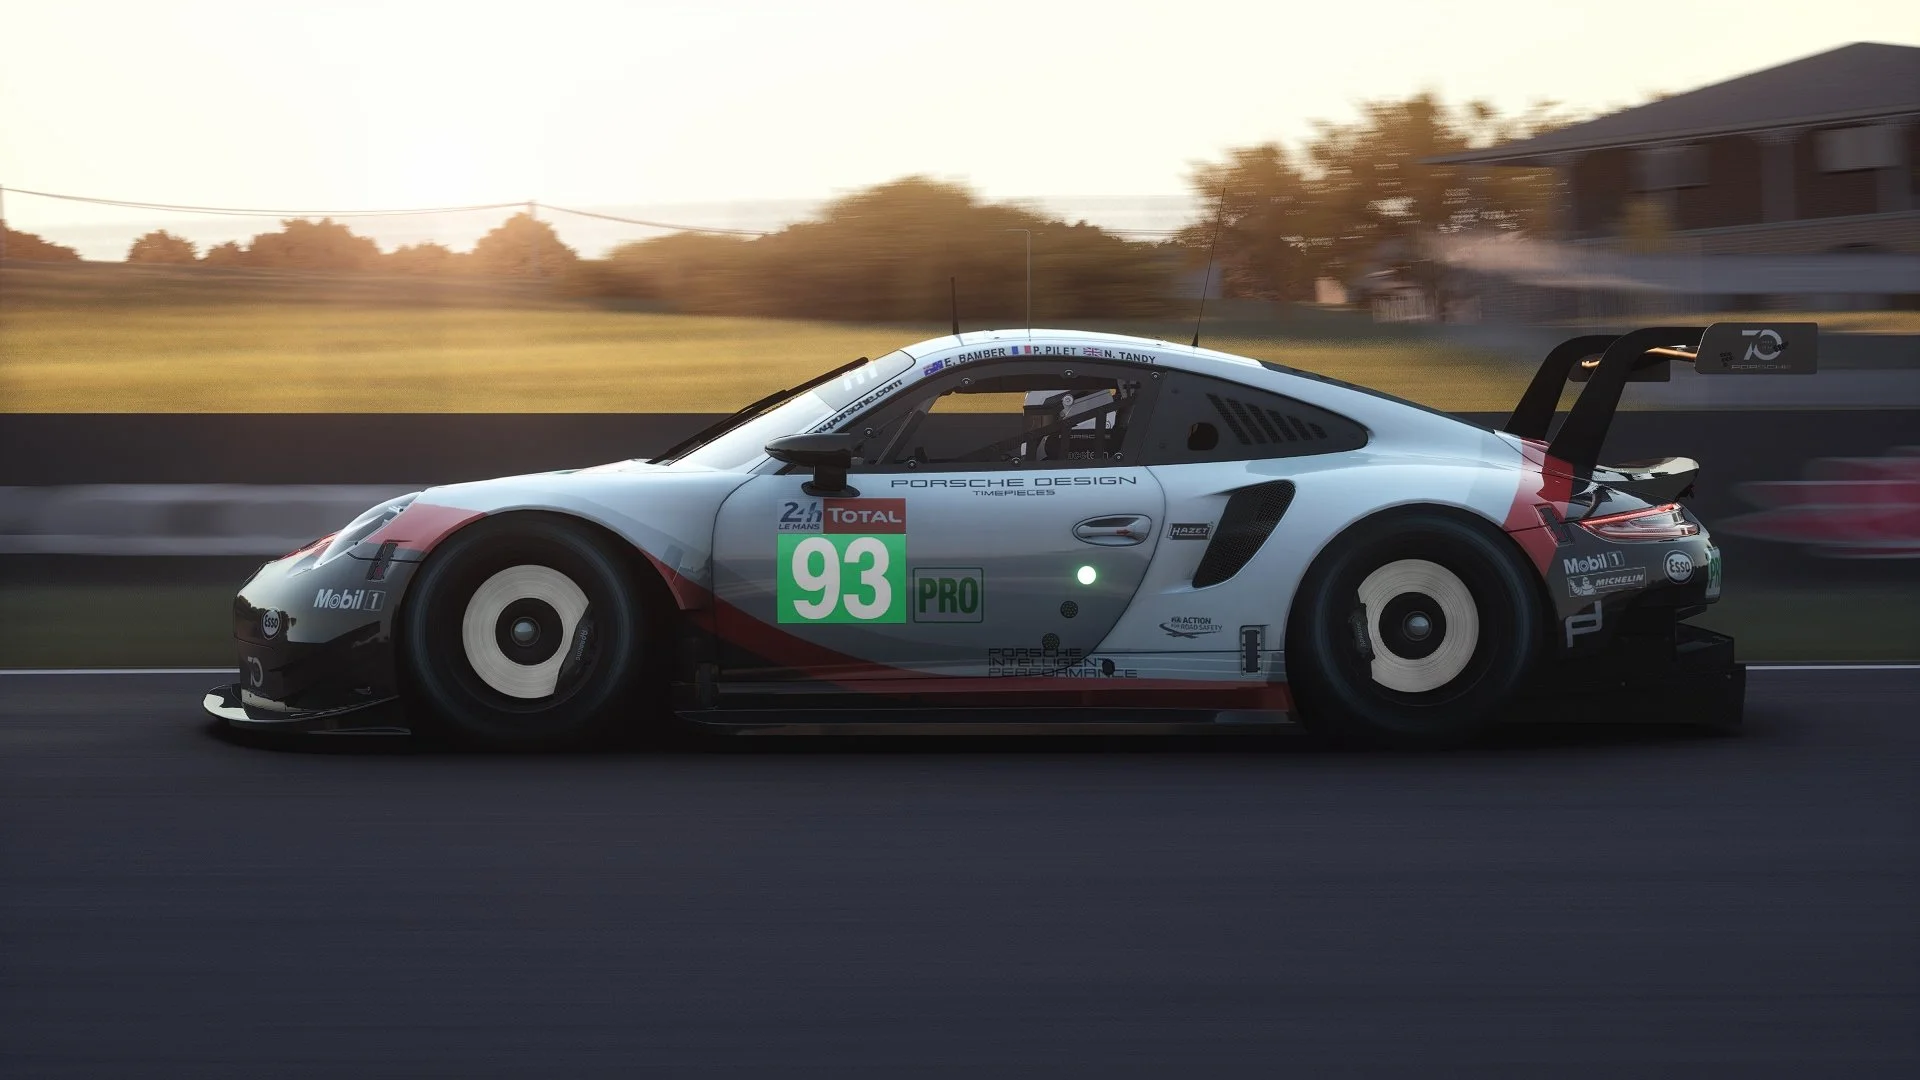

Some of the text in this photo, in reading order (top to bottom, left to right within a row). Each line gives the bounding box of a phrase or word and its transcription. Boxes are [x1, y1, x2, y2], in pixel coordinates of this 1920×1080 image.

[1742, 329, 1784, 361] 70
[959, 347, 1006, 364] BAMBER
[1045, 346, 1077, 356] PILET
[1104, 350, 1116, 359] N.
[1119, 351, 1156, 364] TANDY
[891, 476, 1137, 489] PORSCHE DESIGN
[972, 489, 1056, 497] TIMEPIECES
[827, 507, 902, 523] TOTAL
[1171, 527, 1209, 536] HAZET
[1563, 553, 1608, 575] Mobil
[1669, 558, 1691, 574] Esso
[791, 536, 892, 620] 93
[1595, 574, 1644, 587] MICHELIN
[313, 588, 365, 610] Mobil
[918, 576, 979, 614] PRO
[264, 614, 278, 629] Esso
[1183, 616, 1212, 624] ACTION
[1199, 624, 1223, 632] SAFETY
[988, 648, 1082, 658] PORSCHE
